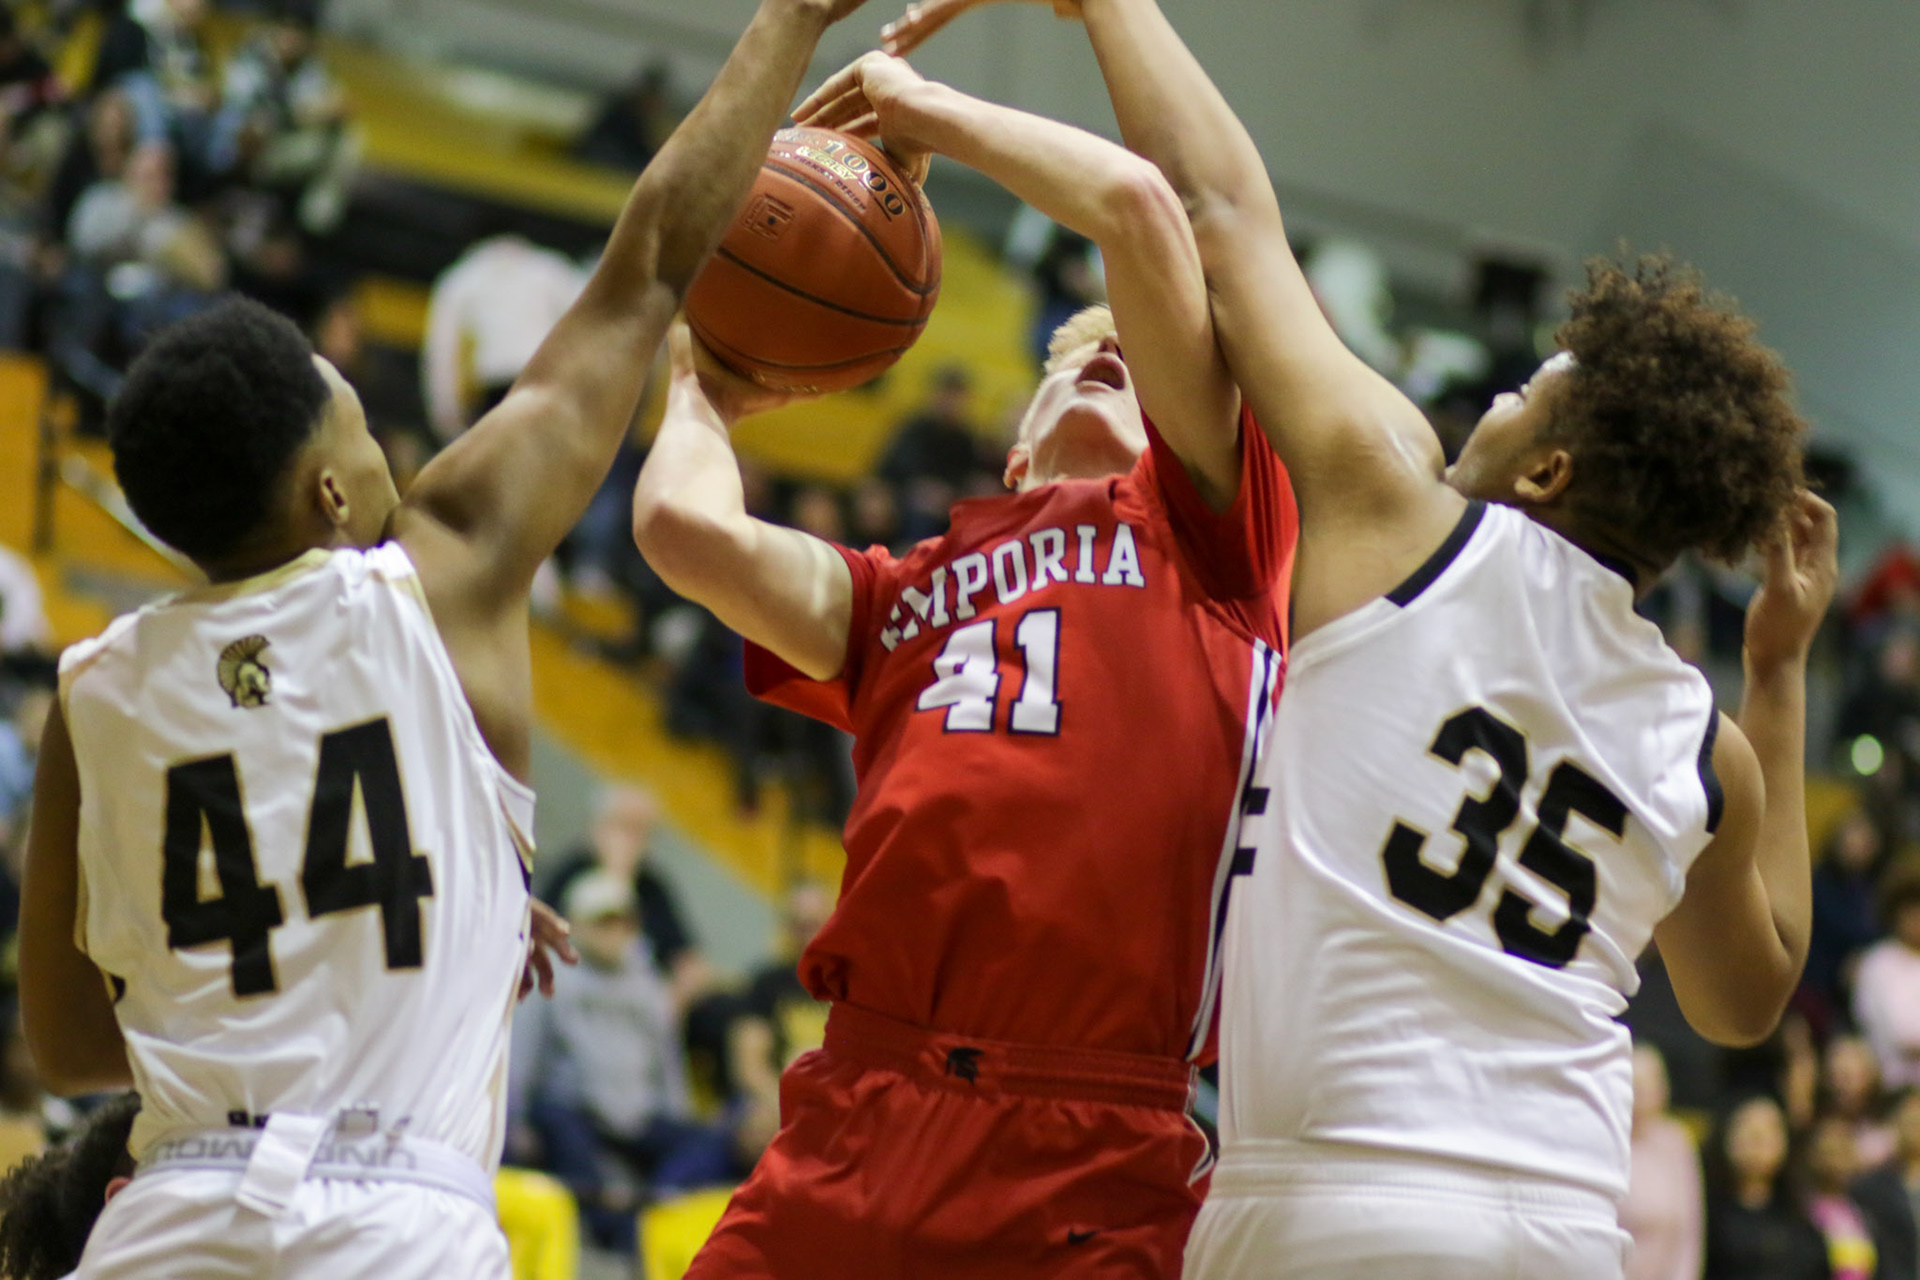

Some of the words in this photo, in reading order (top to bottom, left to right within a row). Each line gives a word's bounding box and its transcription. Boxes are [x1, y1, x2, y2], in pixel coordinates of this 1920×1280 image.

[824, 139, 906, 216] 1000
[914, 606, 1062, 737] 41
[161, 716, 435, 999] 44
[1380, 705, 1630, 971] 35
